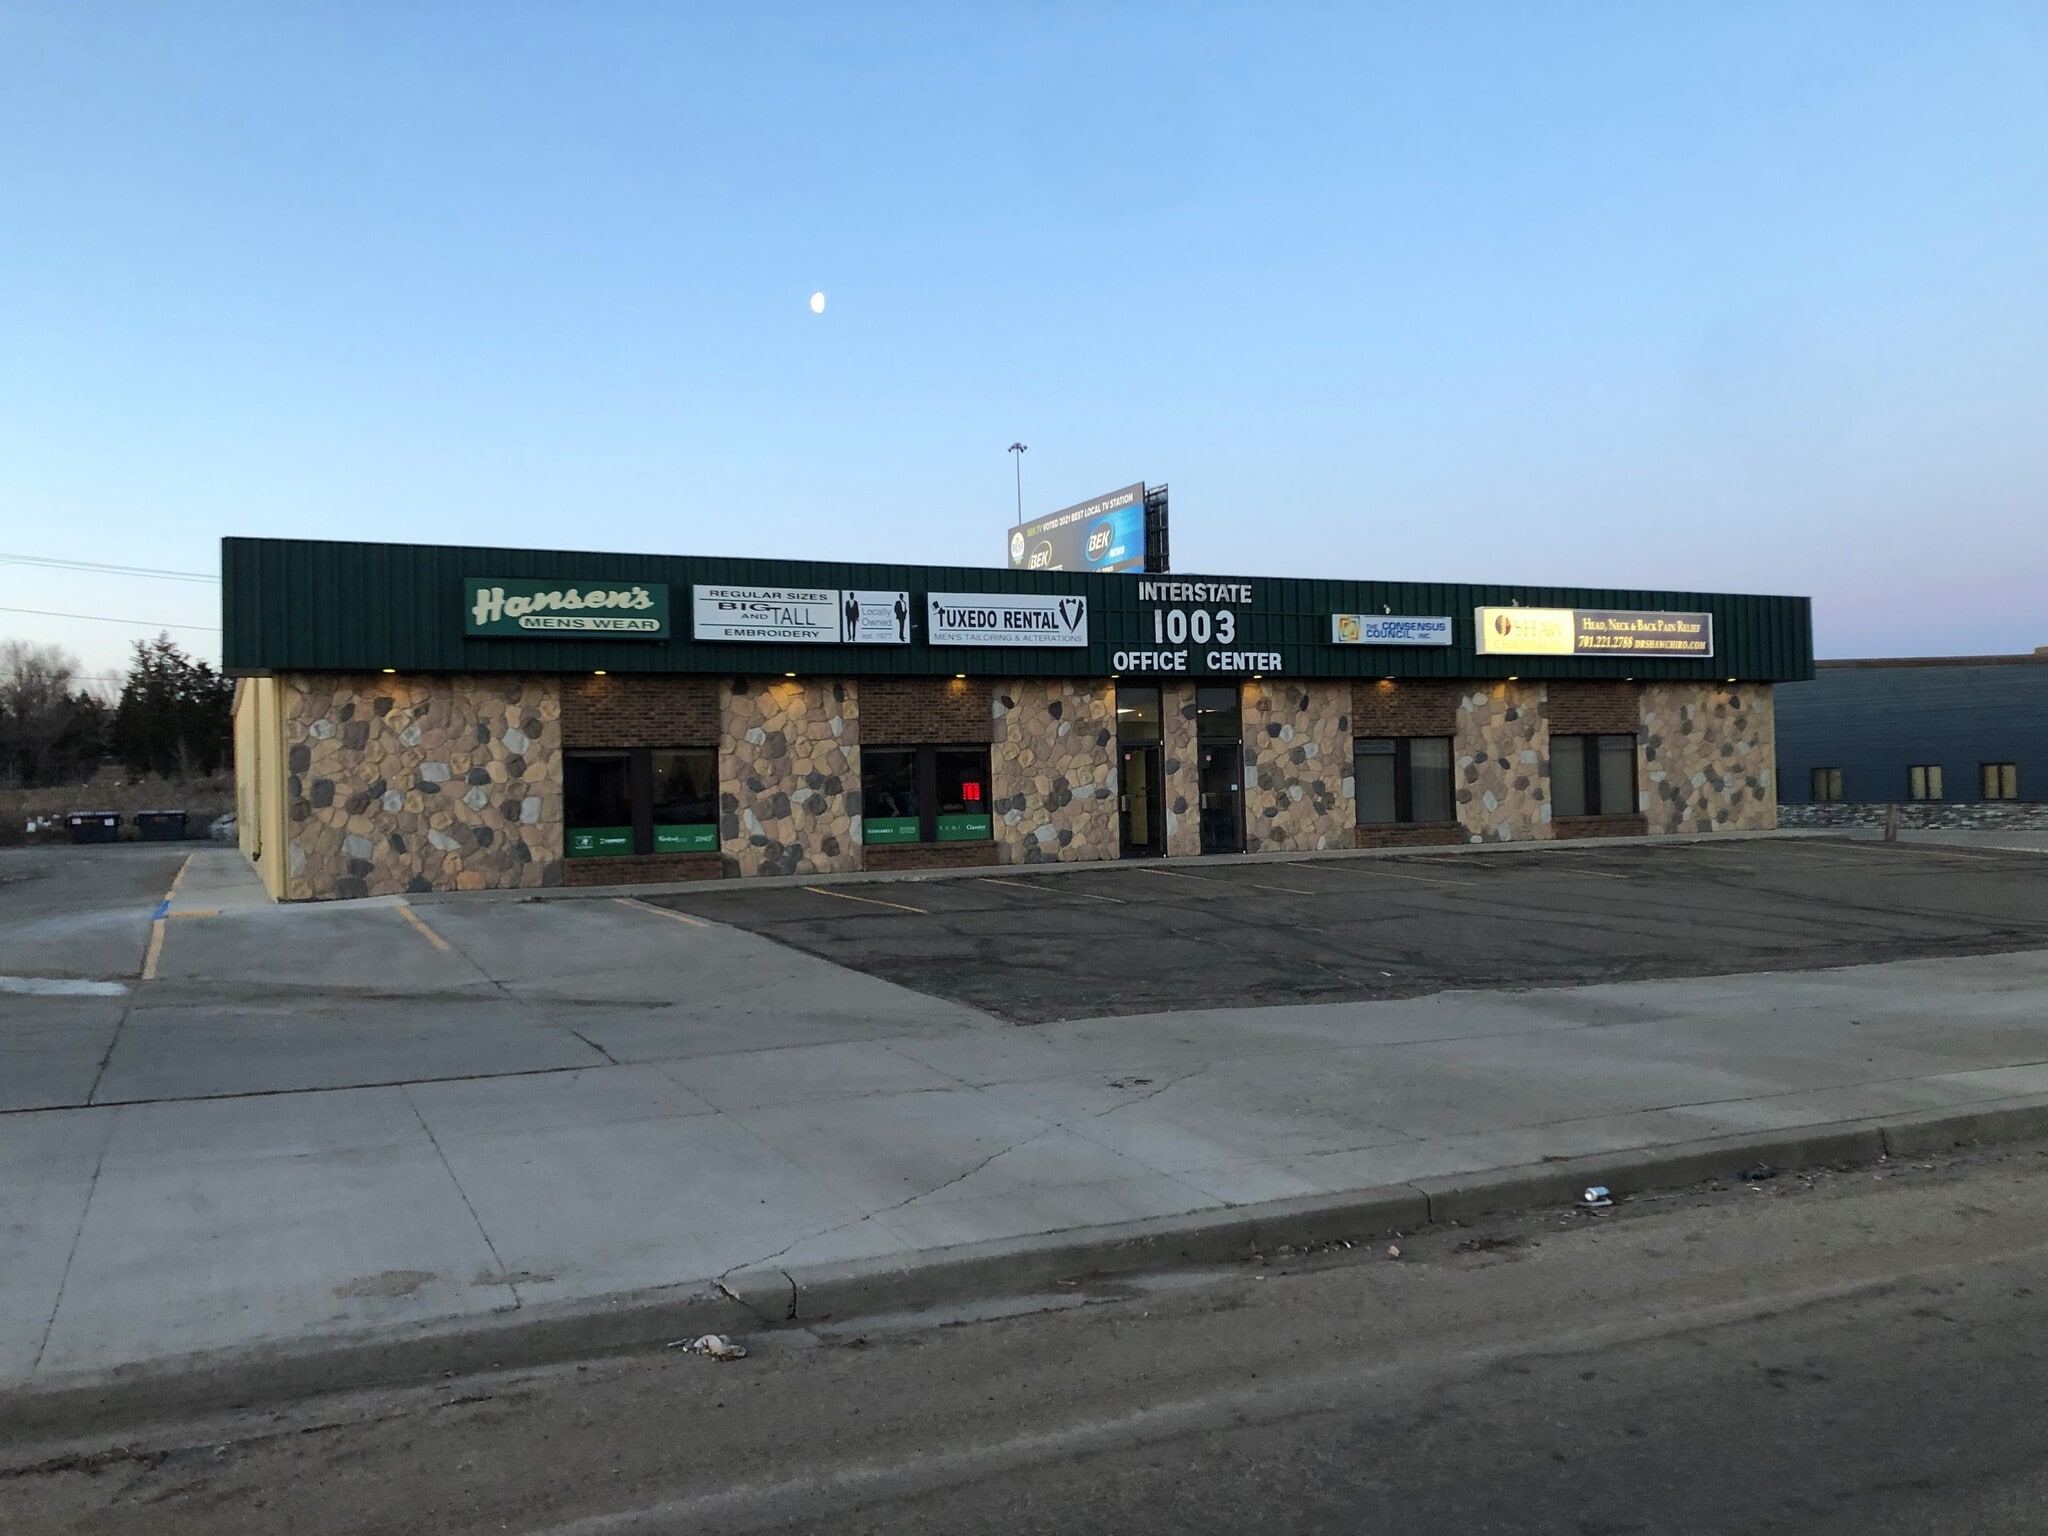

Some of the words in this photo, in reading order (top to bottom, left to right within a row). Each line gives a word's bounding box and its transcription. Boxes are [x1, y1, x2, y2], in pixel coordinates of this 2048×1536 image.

[1043, 519, 1058, 532] VOTED
[1059, 514, 1070, 526] 2021
[1071, 510, 1083, 522] BEST
[1084, 505, 1101, 517] LOCAL
[1102, 501, 1109, 511] TV
[1110, 493, 1133, 508] STATION
[1089, 530, 1110, 552] BEK
[1030, 550, 1049, 570] BEK
[709, 589, 783, 600] REGULAR
[787, 592, 828, 601] SIZES
[1138, 581, 1253, 603] INTERSTATE
[472, 587, 655, 626] Hansen's
[718, 602, 772, 611] BIG
[769, 607, 816, 626] TALL
[861, 606, 891, 619] Locally
[524, 617, 585, 629] MENS
[593, 619, 654, 630] WEAR
[861, 617, 893, 627] Owned
[938, 608, 997, 628] TUXEDO
[1004, 610, 1060, 630] RENTAL
[1154, 608, 1236, 645] 1003
[1382, 622, 1446, 631] CONSENSUS
[1608, 618, 1631, 631] NECK
[1631, 622, 1638, 631] &
[1637, 618, 1657, 632] BACK
[1657, 619, 1676, 632] PAIN
[1676, 620, 1702, 633] RELIEF
[724, 628, 820, 639] EMBROIDERY
[934, 633, 962, 641] MEN'S
[965, 634, 1012, 642] TAILORING
[1015, 634, 1020, 642] &
[1023, 634, 1083, 643] ALTERATIONS
[1366, 629, 1415, 640] COUNCIL,
[1578, 635, 1633, 649] 701.221.2788
[1112, 650, 1188, 671] OFFICE
[1206, 652, 1283, 671] CENTER
